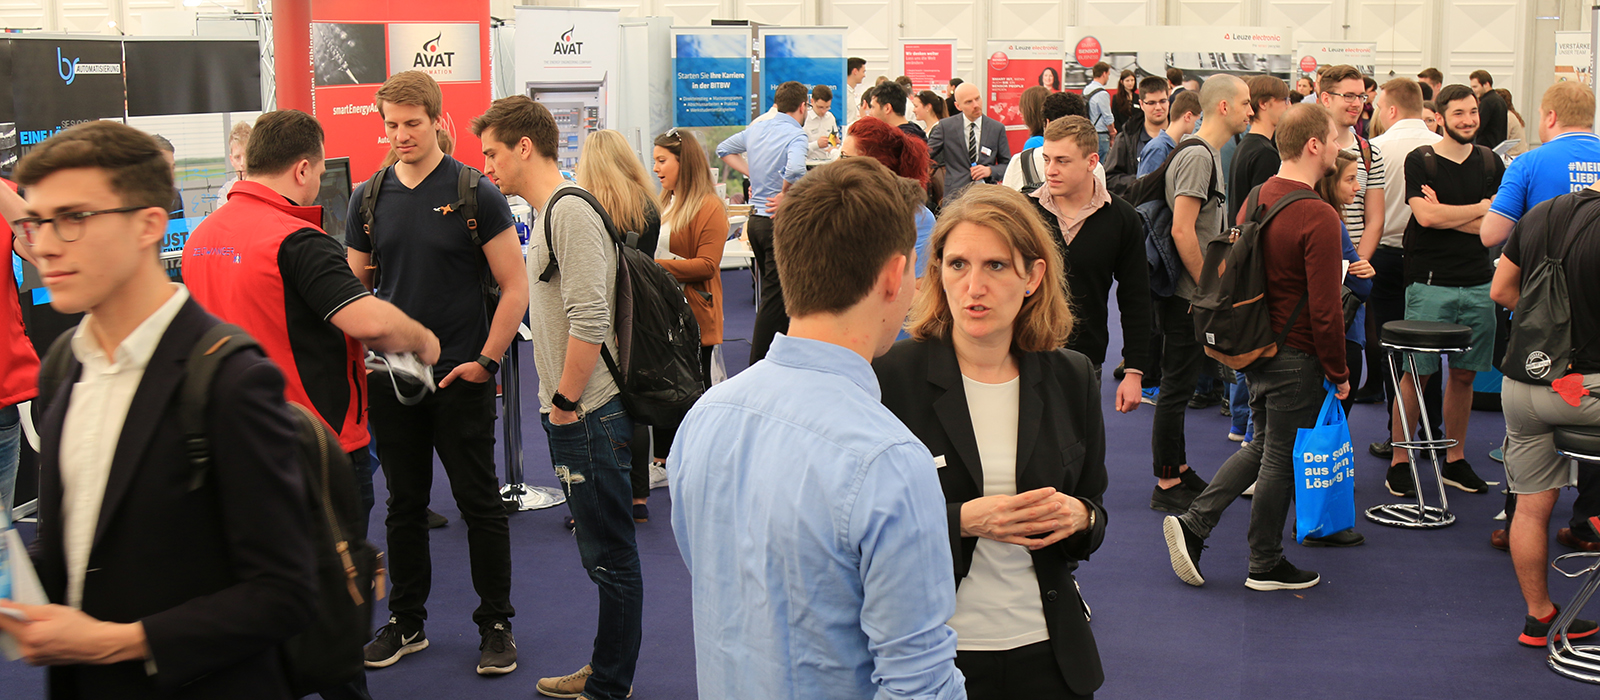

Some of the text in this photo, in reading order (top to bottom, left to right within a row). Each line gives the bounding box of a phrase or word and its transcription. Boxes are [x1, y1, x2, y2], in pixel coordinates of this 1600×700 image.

[553, 41, 584, 55] AVAT
[413, 52, 455, 68] AVAT
[76, 65, 119, 73] AUTOMATISIERUNG
[677, 71, 745, 80] Starten Sie Ihre Karriere
[1303, 452, 1329, 463] Der
[1304, 467, 1329, 477] aus
